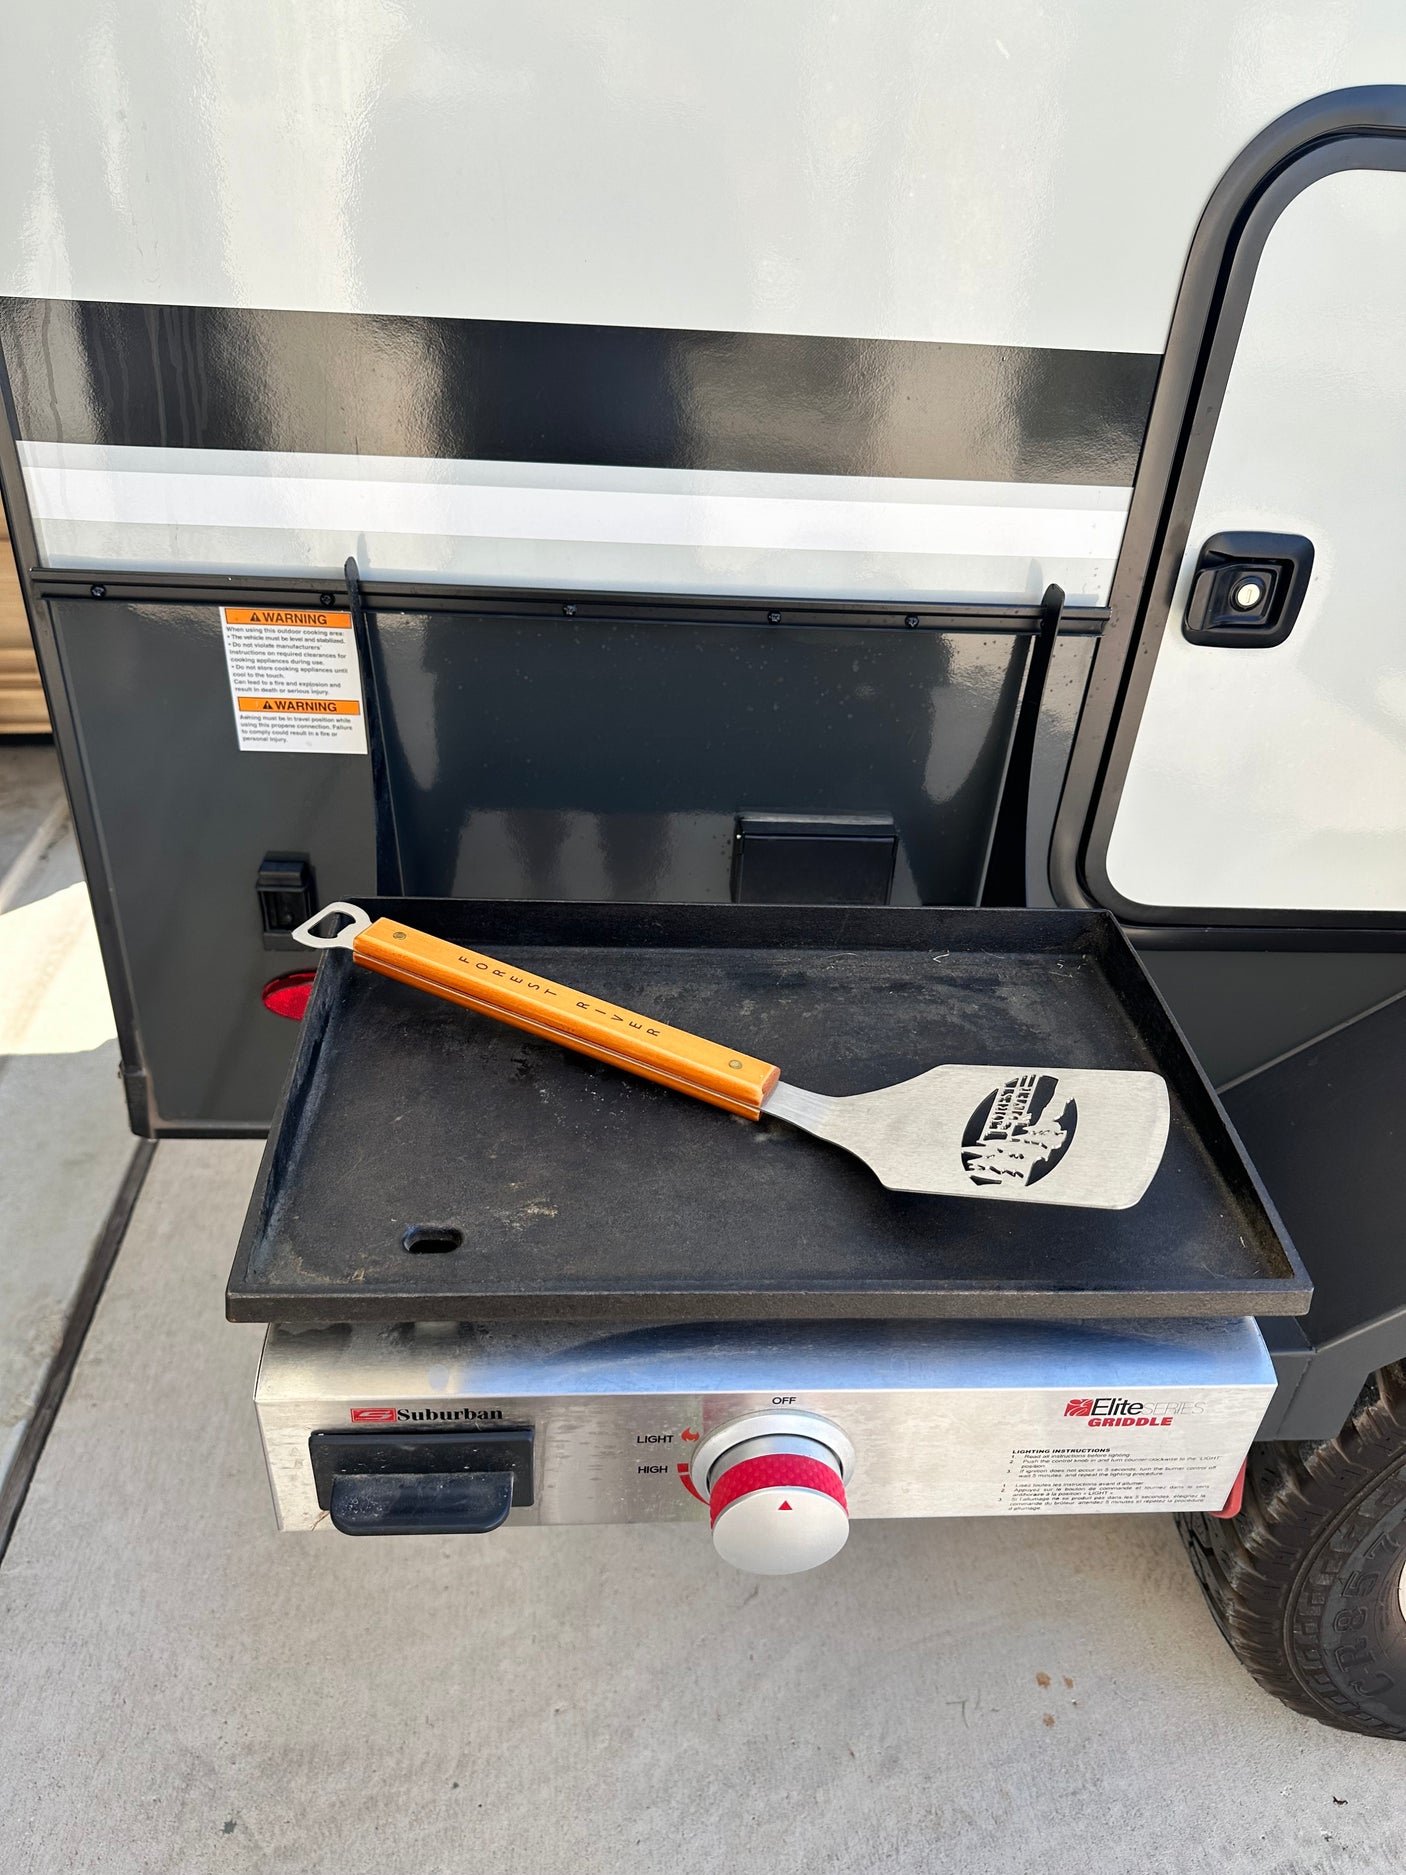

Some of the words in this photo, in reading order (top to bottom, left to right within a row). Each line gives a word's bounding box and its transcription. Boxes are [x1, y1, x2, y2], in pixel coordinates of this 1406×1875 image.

[262, 612, 327, 625] WARNING
[303, 629, 328, 637] cooking
[274, 700, 338, 712] WARNING
[458, 956, 557, 996] FOREST
[576, 1001, 660, 1037] RIVER
[772, 1396, 797, 1405] OFF
[398, 1408, 503, 1422] Suburban
[1088, 1416, 1173, 1428] GRIDDLE
[637, 1434, 674, 1444] LIGHT
[637, 1464, 668, 1474] HIGH
